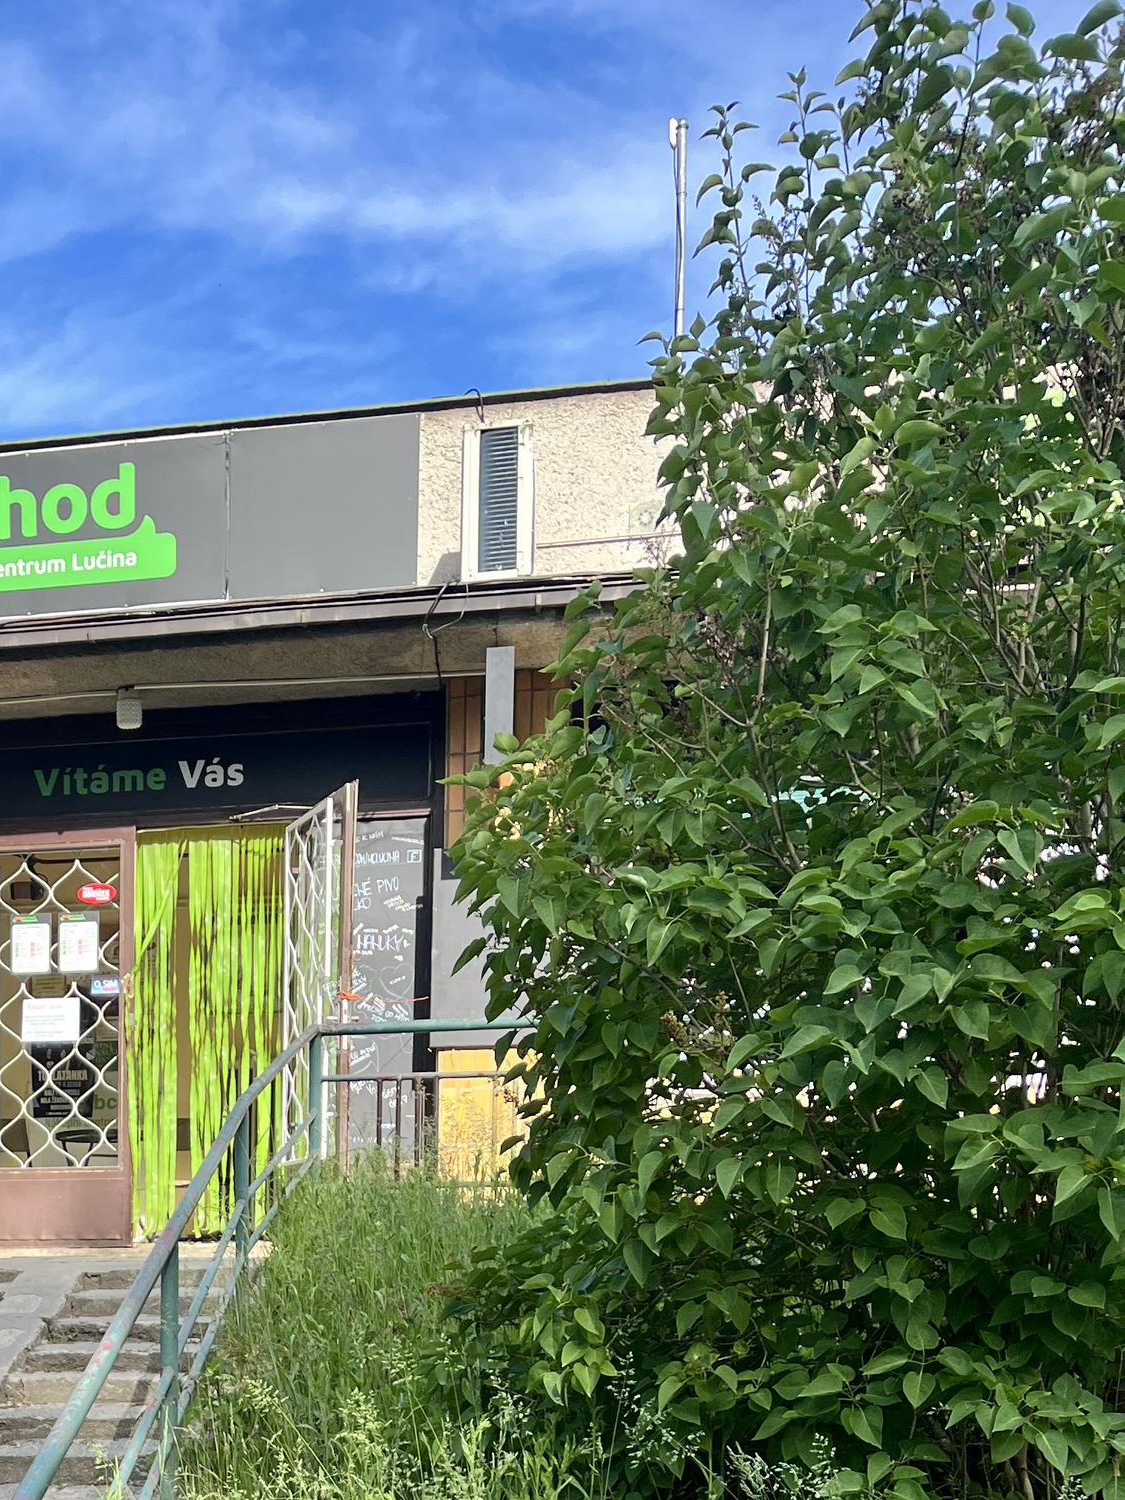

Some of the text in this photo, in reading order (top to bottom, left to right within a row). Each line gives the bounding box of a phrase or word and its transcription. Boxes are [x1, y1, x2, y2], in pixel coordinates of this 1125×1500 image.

[72, 549, 138, 571] Lučina
[33, 757, 244, 797] Vítáme Vás
[377, 876, 400, 893] PIVO
